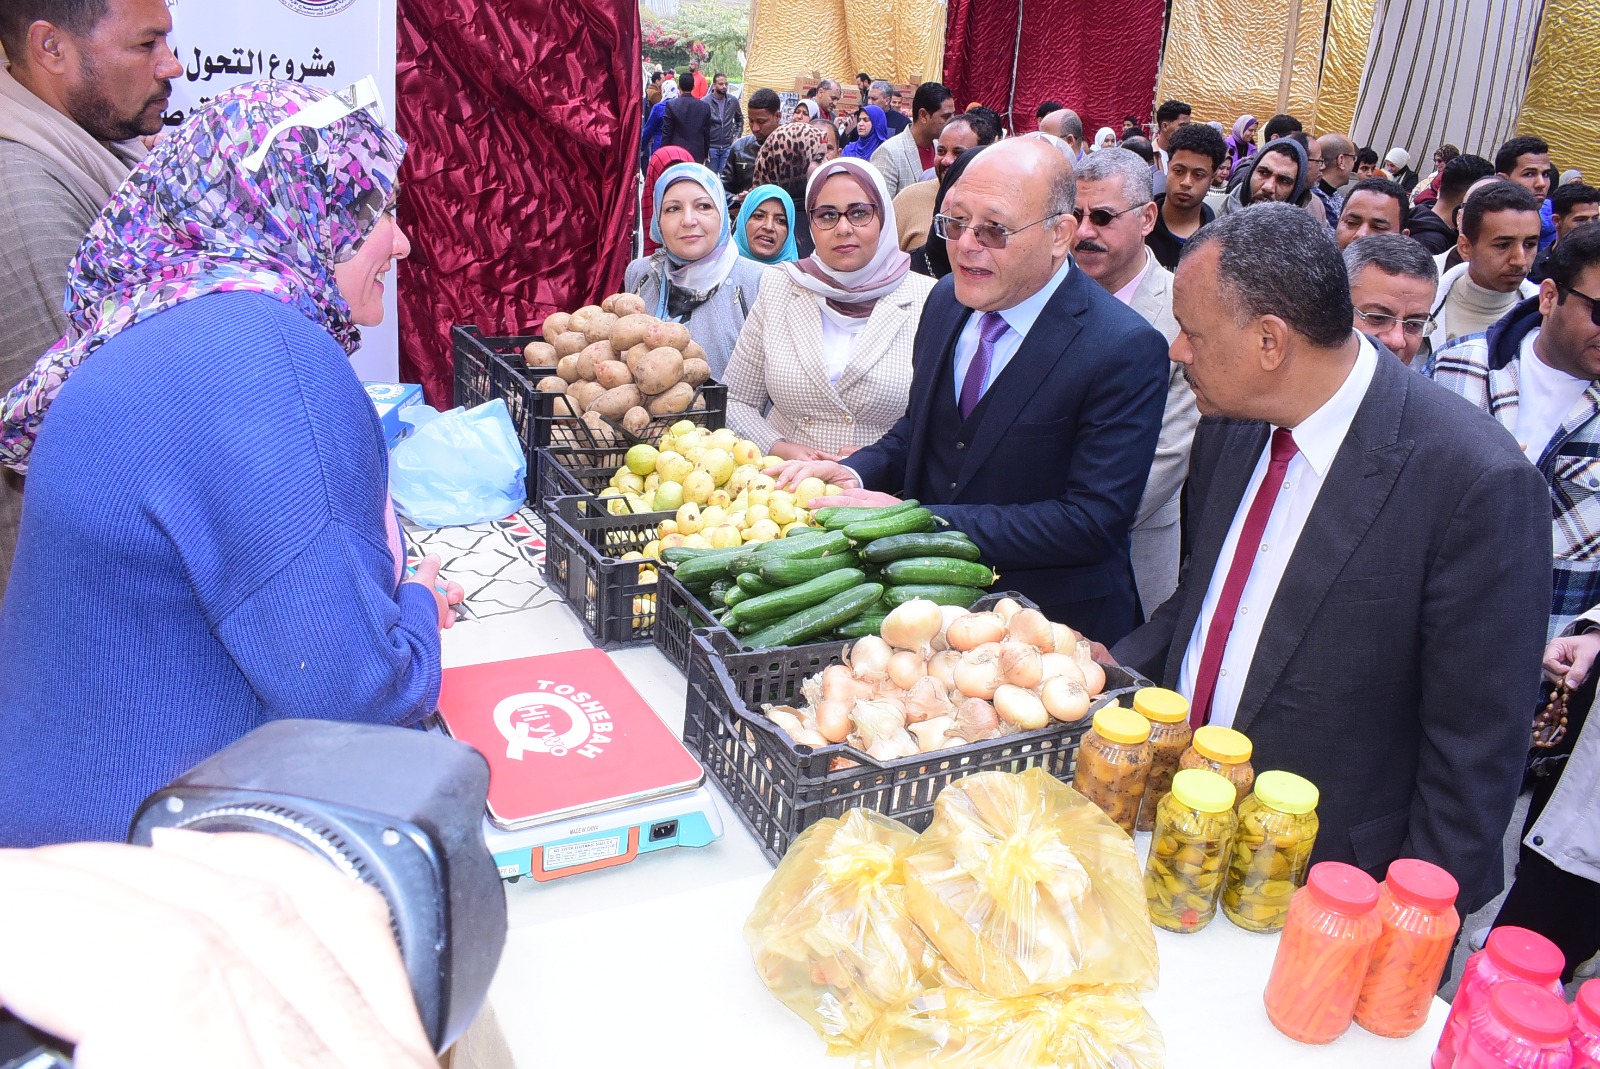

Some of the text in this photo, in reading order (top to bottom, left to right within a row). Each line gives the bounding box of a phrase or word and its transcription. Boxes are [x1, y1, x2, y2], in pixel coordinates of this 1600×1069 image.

[186, 46, 336, 83] مشروع التحول
[536, 679, 614, 759] TOSHEBAH
[569, 827, 581, 835] MADE
